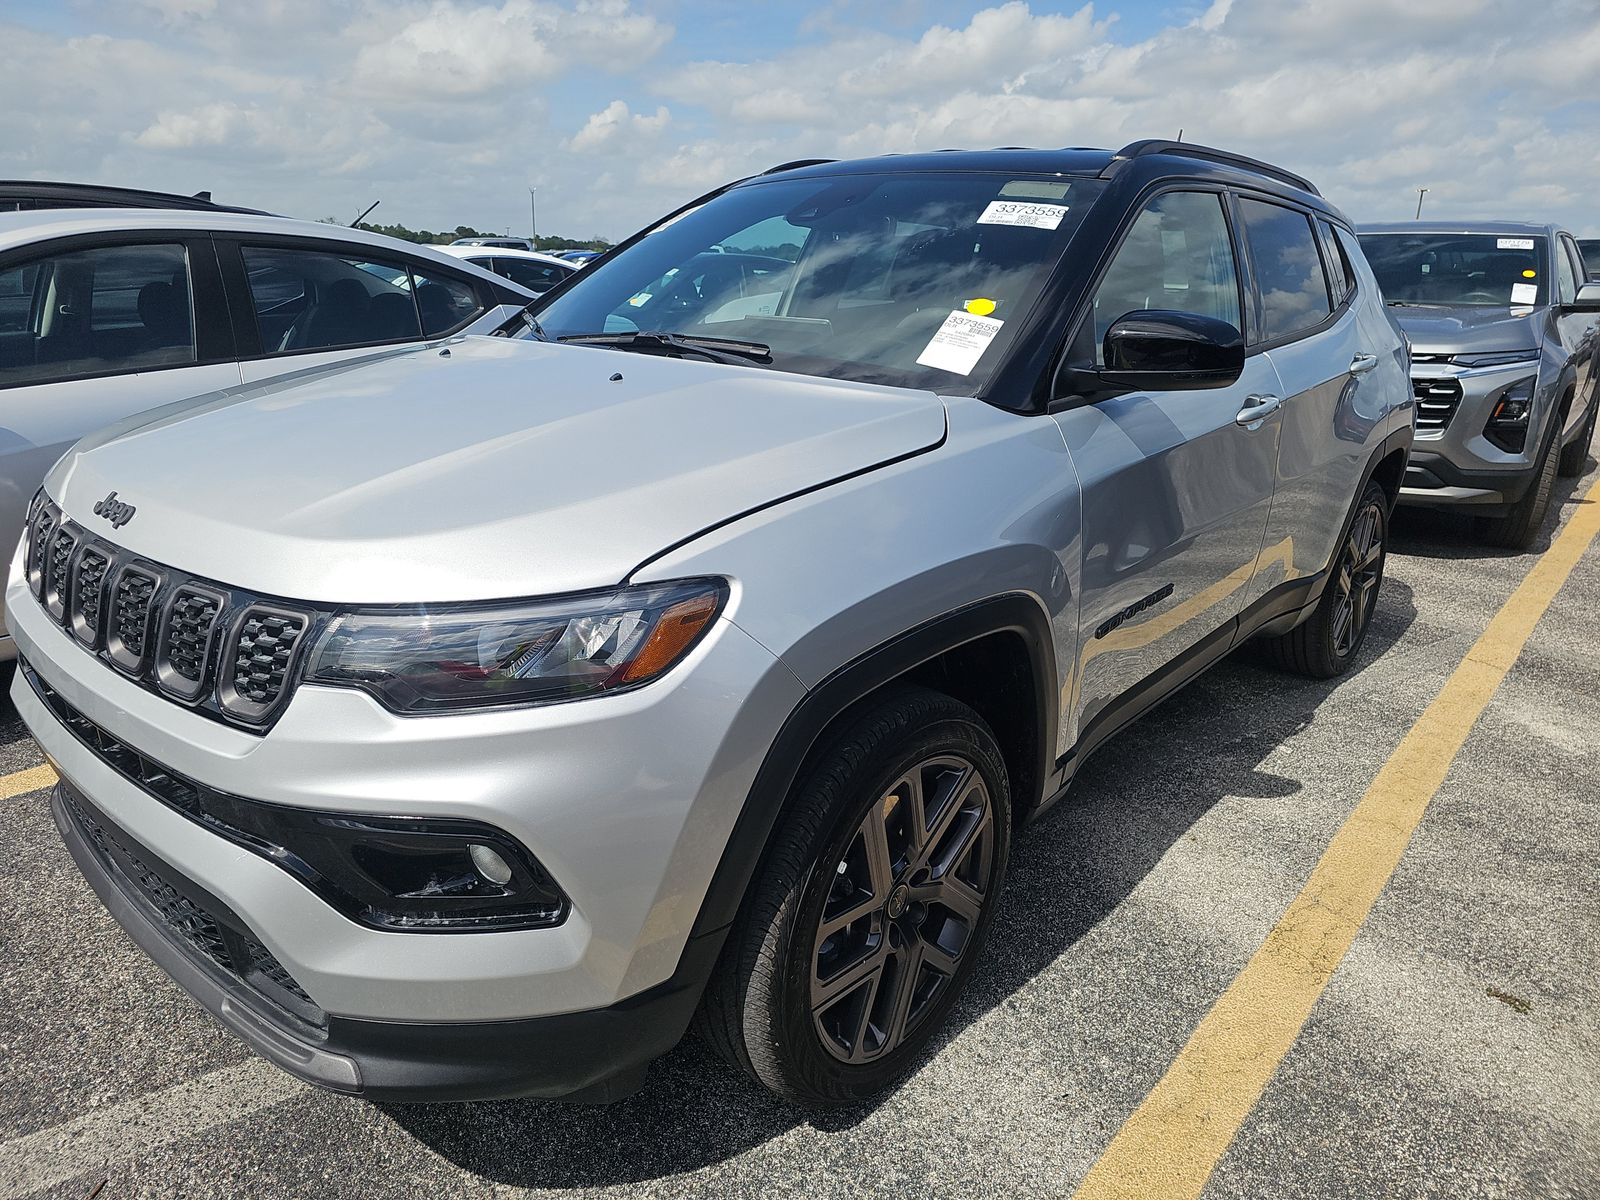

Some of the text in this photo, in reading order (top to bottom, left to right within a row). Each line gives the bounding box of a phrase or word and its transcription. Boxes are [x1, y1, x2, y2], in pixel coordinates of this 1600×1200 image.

[995, 203, 1067, 218] 3373559
[949, 316, 999, 334] 3373559
[93, 490, 136, 530] Jeep
